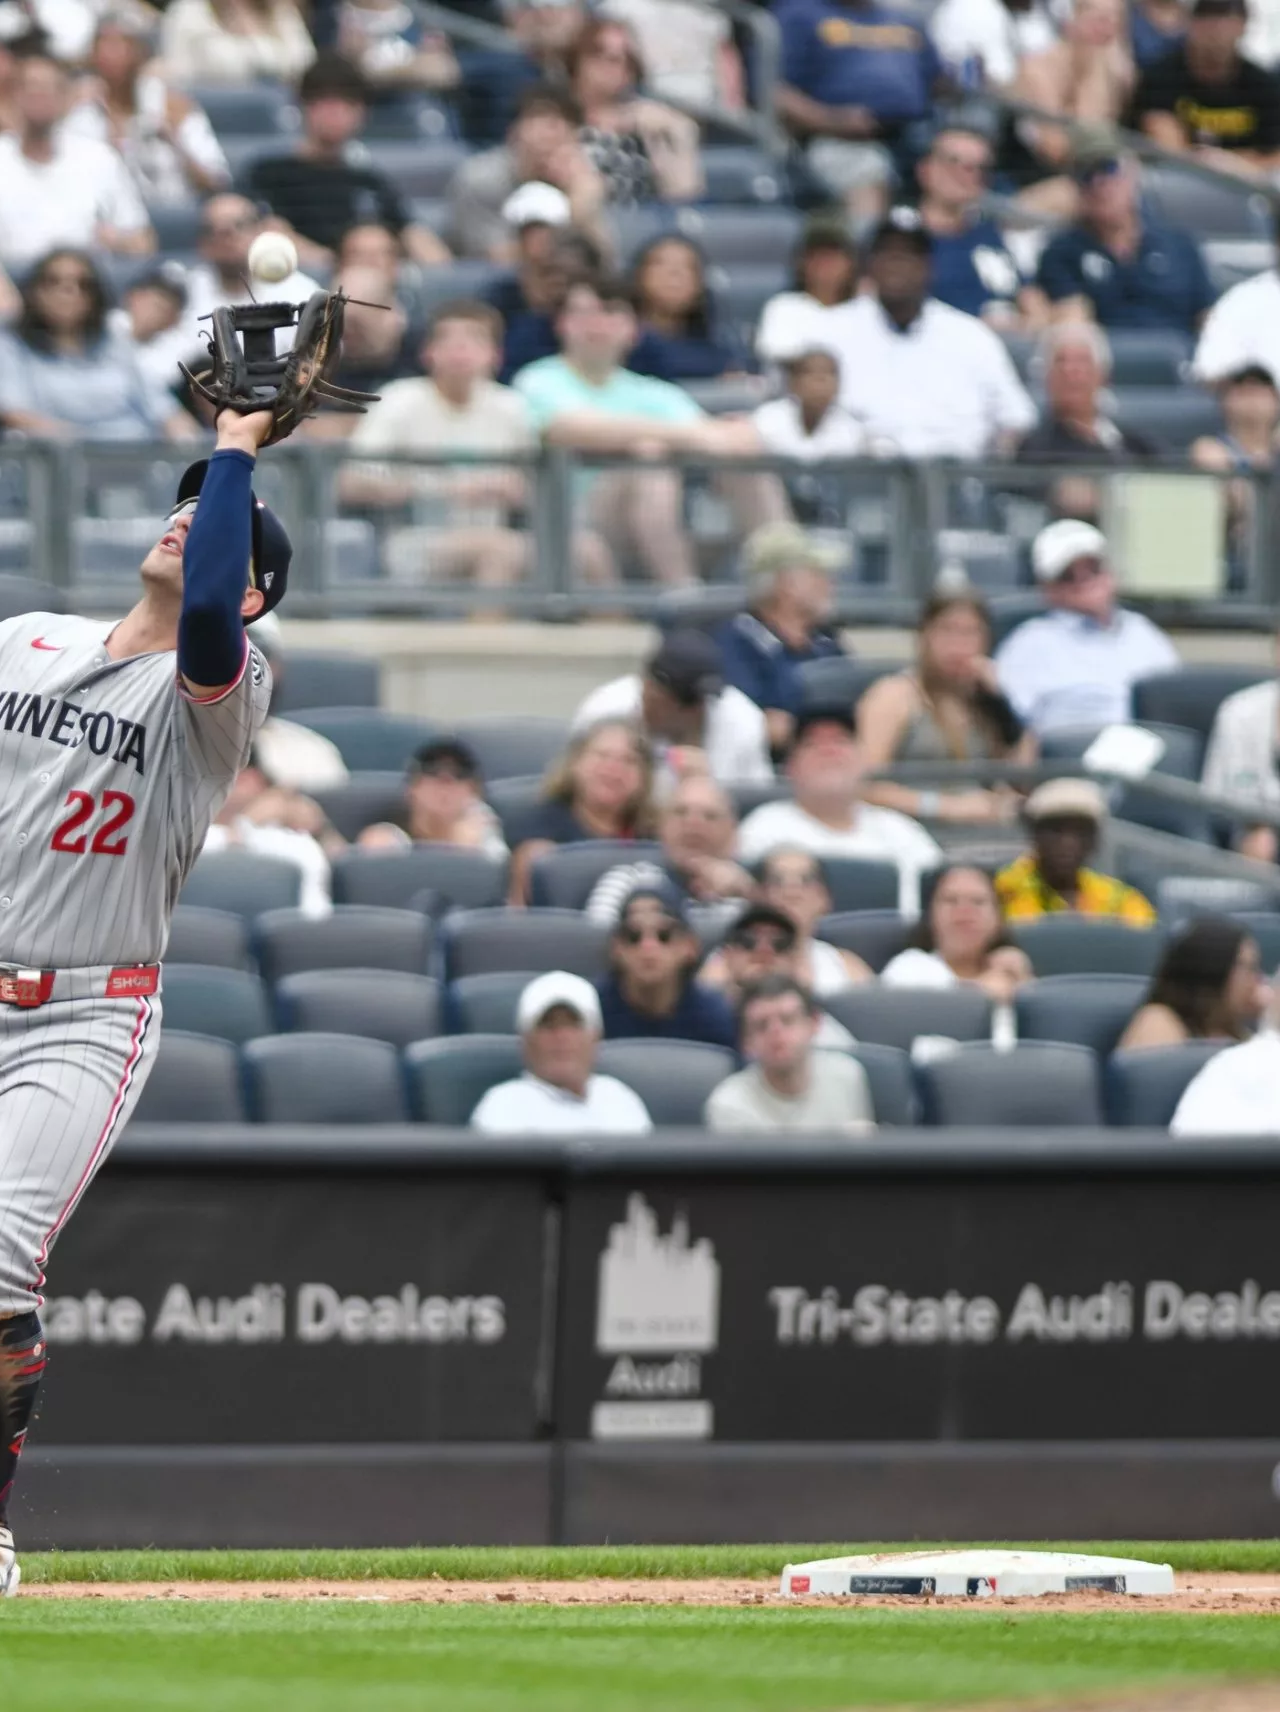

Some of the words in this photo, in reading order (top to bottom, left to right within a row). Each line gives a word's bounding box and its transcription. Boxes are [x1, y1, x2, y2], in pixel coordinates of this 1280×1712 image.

[51, 790, 136, 856] 22
[152, 1283, 286, 1343] Audi
[296, 1283, 505, 1344] Dealers
[769, 1285, 1000, 1344] Tri-State
[1007, 1281, 1132, 1340] Audi
[606, 1353, 701, 1396] Audi
